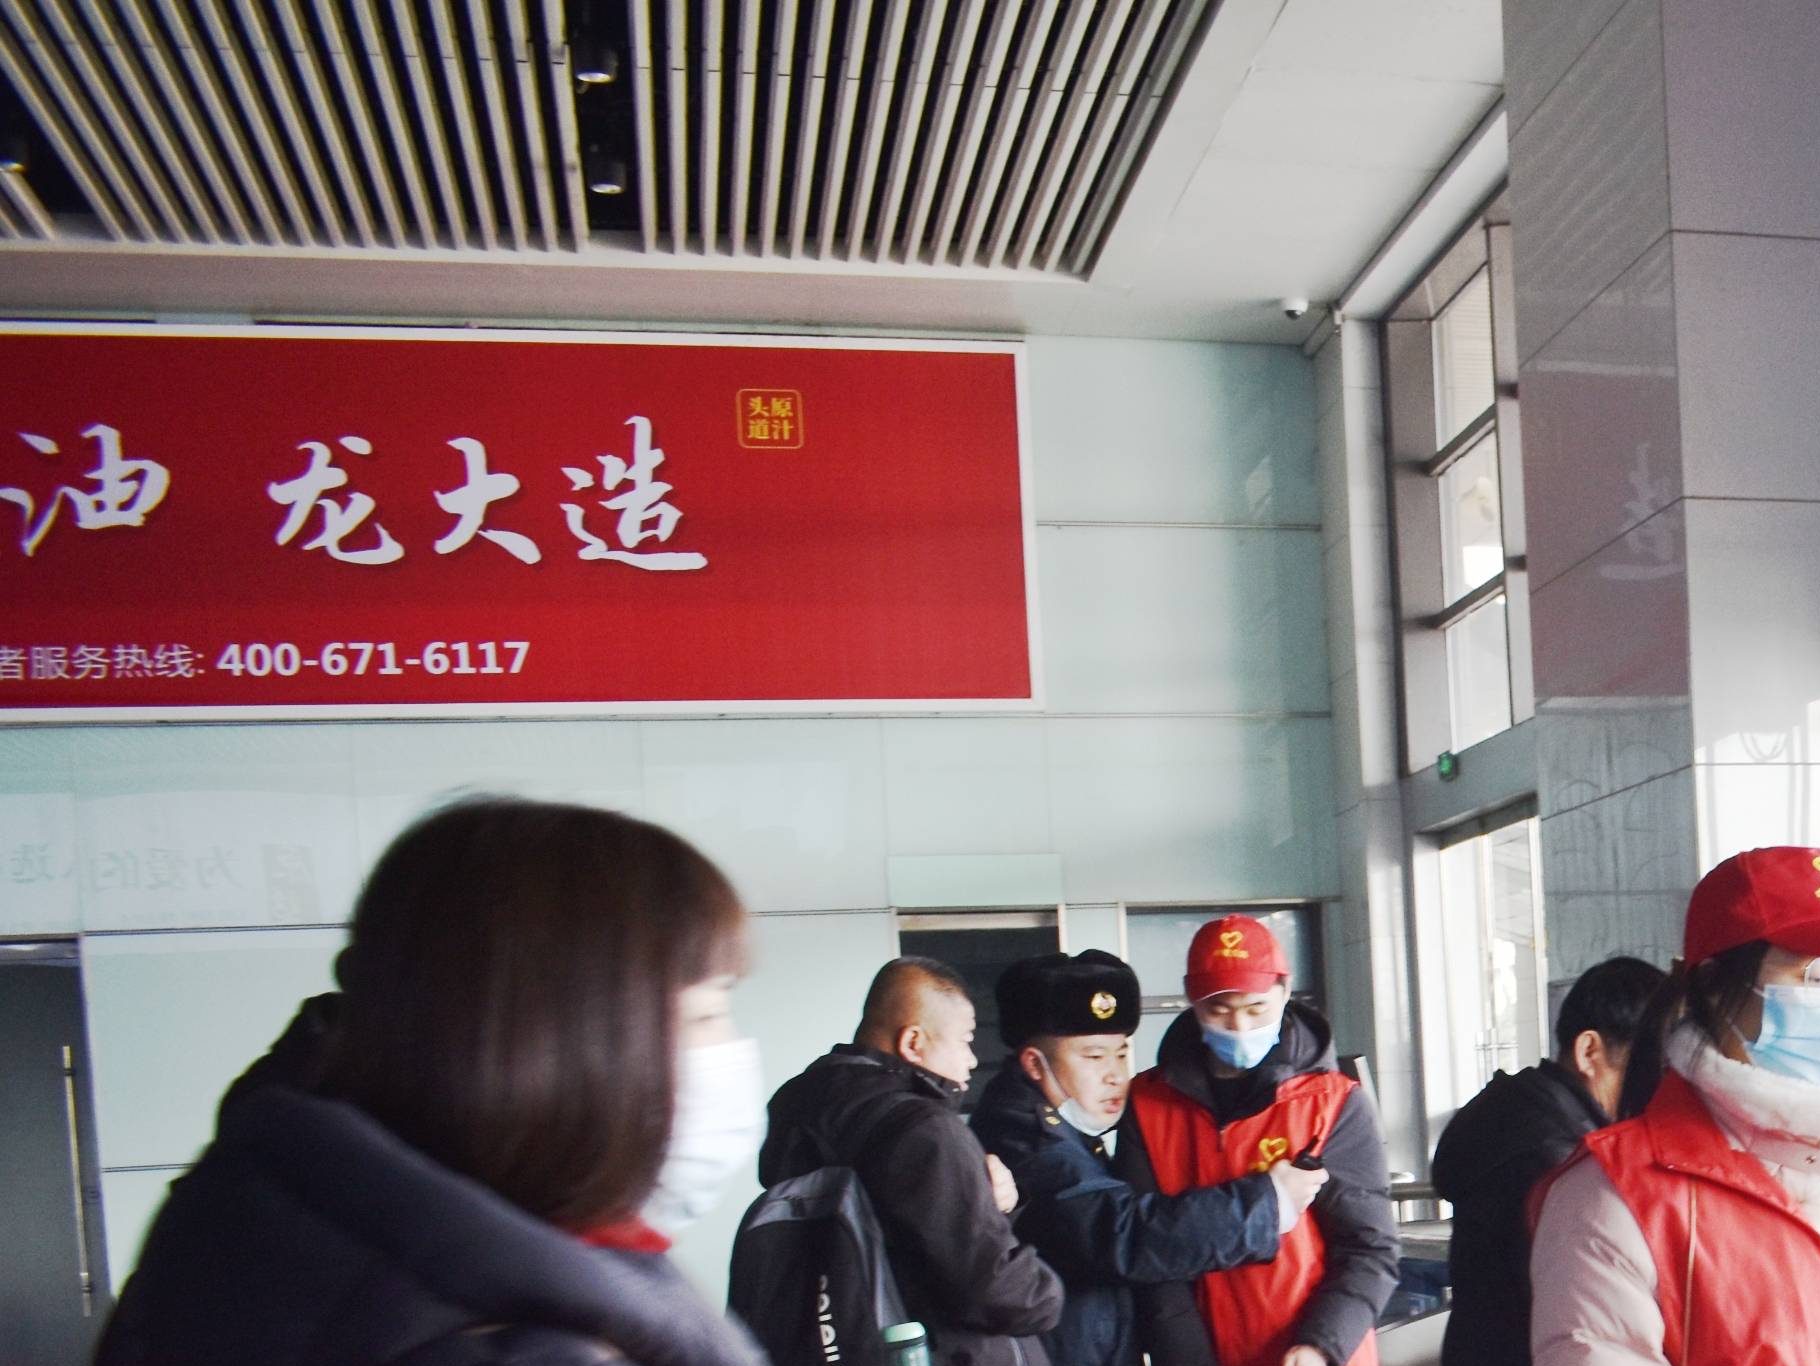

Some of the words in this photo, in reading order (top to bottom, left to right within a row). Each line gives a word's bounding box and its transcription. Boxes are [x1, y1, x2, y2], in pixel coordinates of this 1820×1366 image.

[0, 423, 171, 556] 油
[267, 415, 708, 571] 龙大造
[216, 641, 531, 677] 400-671-6117
